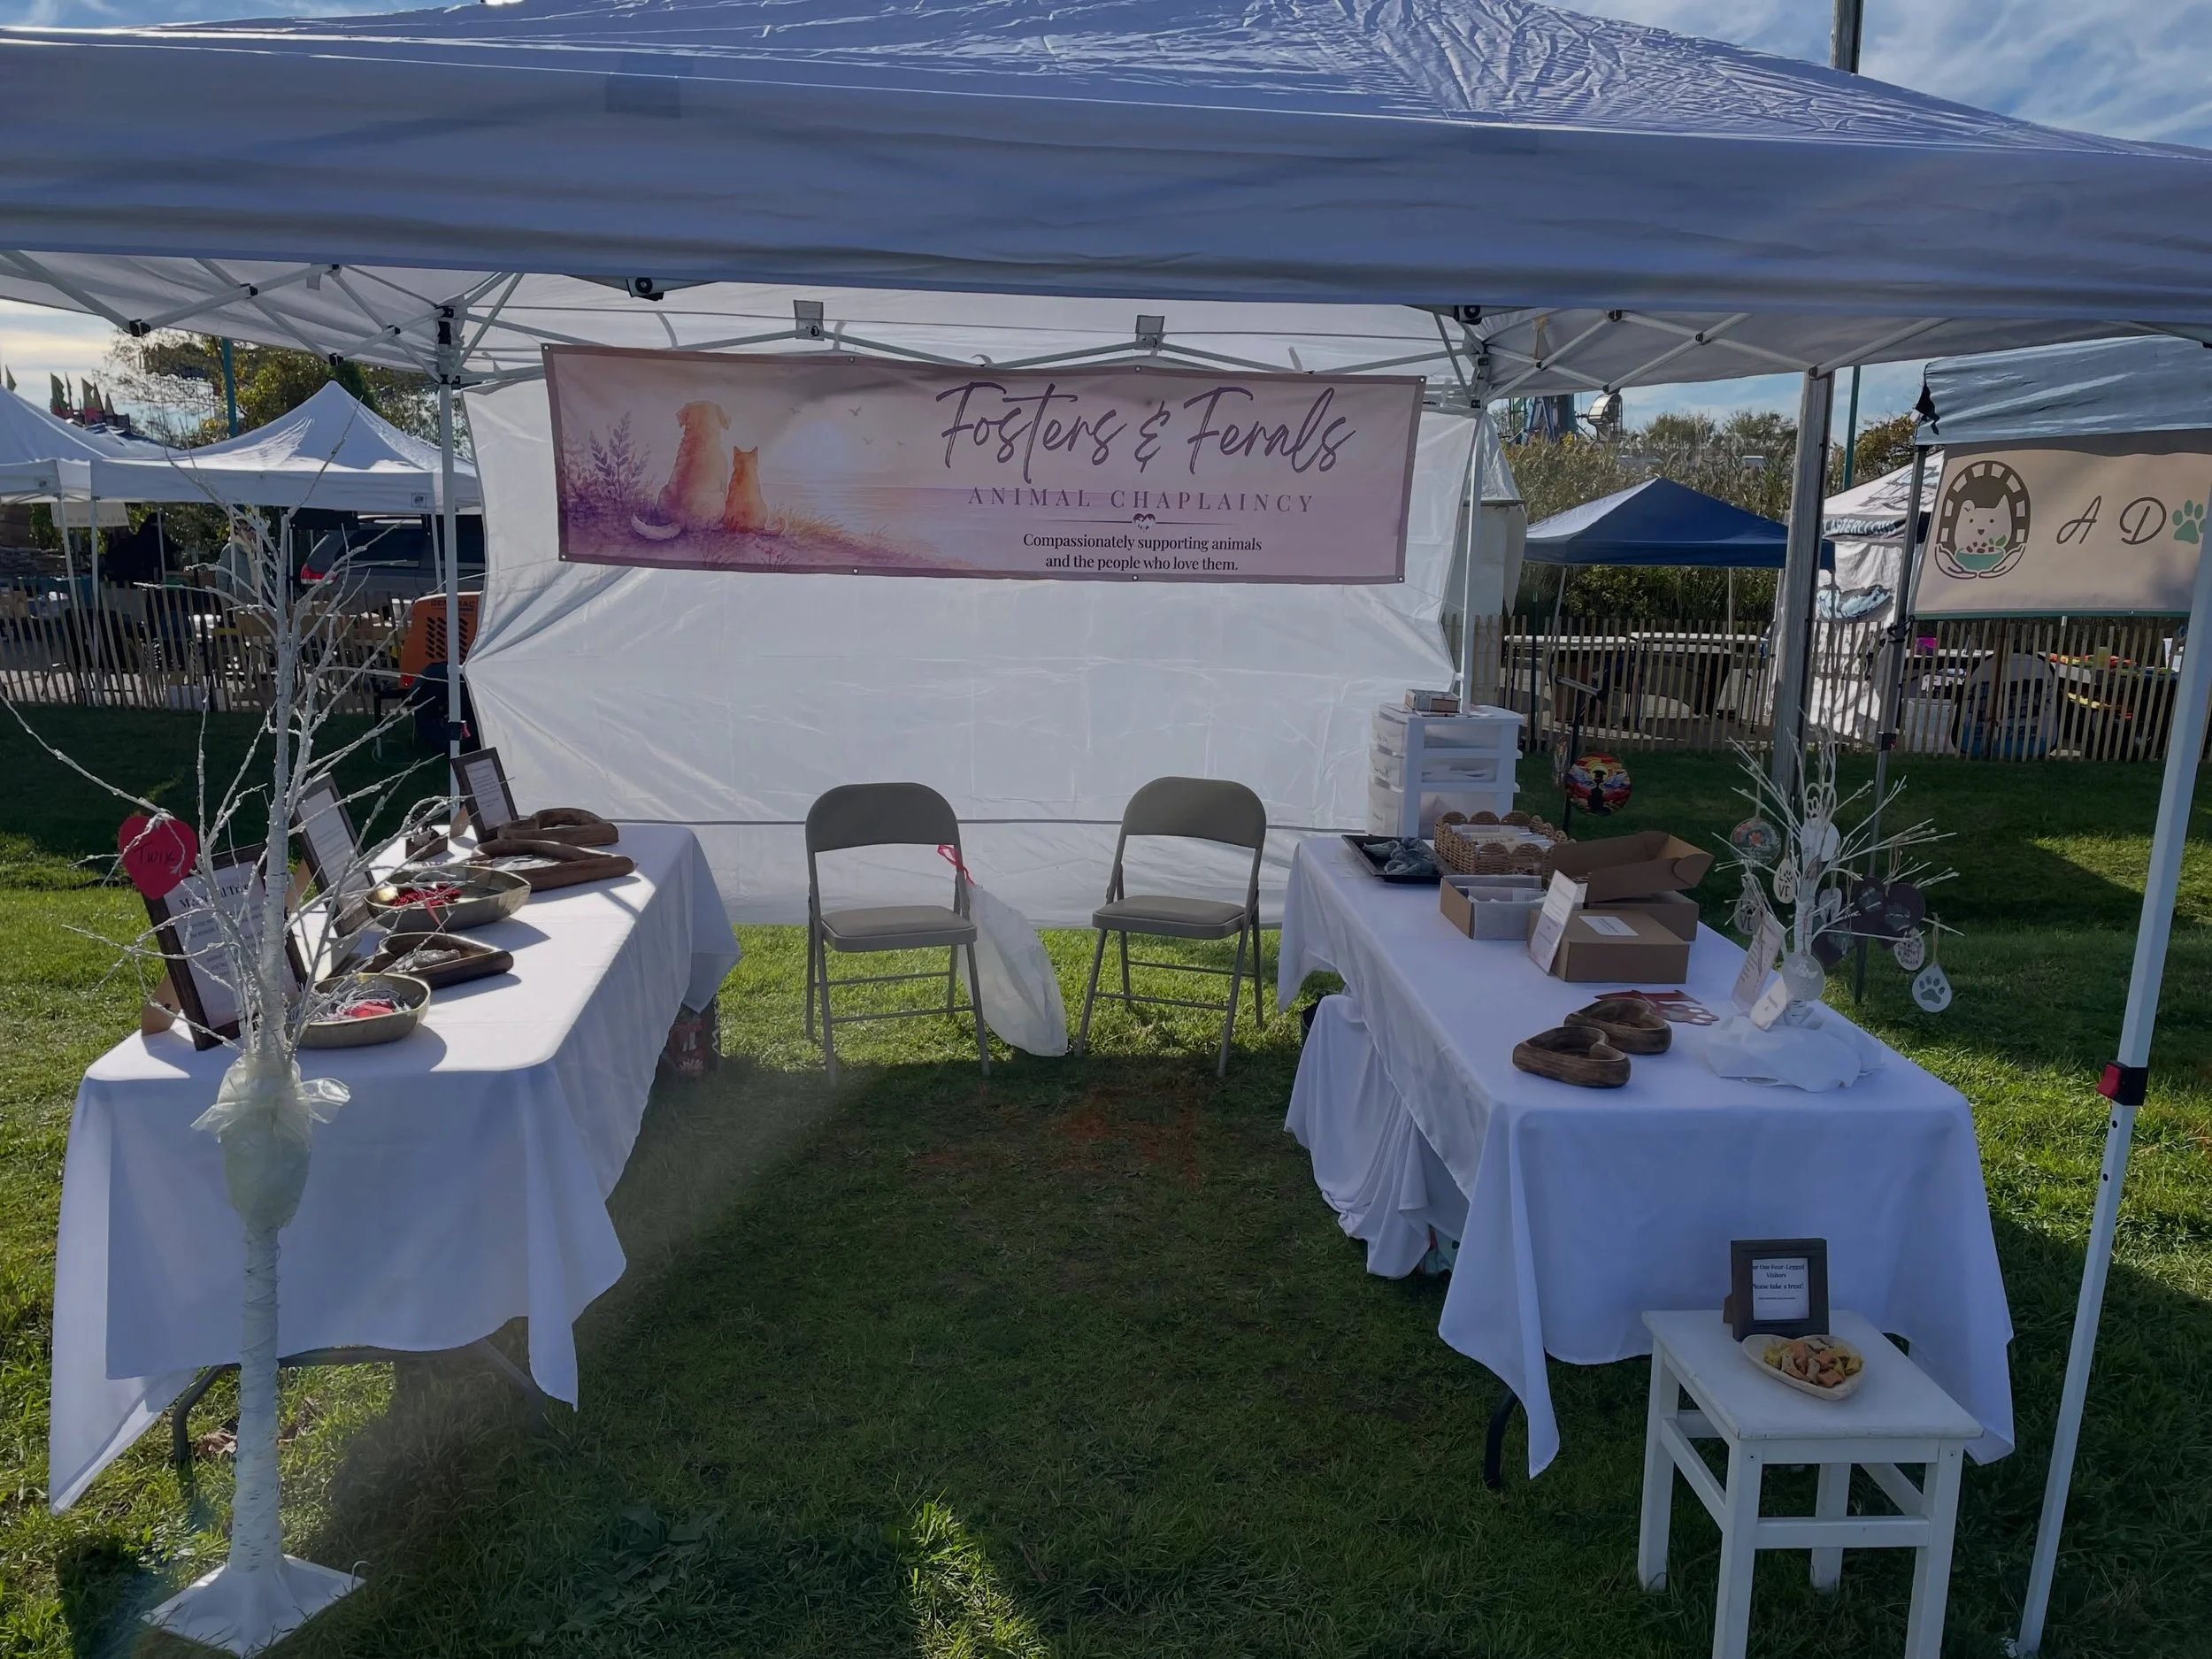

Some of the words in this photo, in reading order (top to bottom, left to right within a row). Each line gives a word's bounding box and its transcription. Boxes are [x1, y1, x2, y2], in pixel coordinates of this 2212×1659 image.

[936, 381, 1127, 484] Fosters
[1134, 400, 1171, 473] &
[1183, 387, 1356, 475] Ferals
[968, 487, 1090, 507] ANIMAL
[1110, 489, 1313, 512] CHAPLAINCY
[1023, 534, 1135, 550] Compassionately
[1137, 536, 1209, 552] supporting
[1211, 537, 1263, 551] animals
[1045, 555, 1071, 568] and
[1073, 555, 1094, 569] the
[1097, 556, 1141, 572] people
[1142, 556, 1171, 570] who
[1173, 557, 1199, 570] love
[1202, 557, 1240, 571] them.
